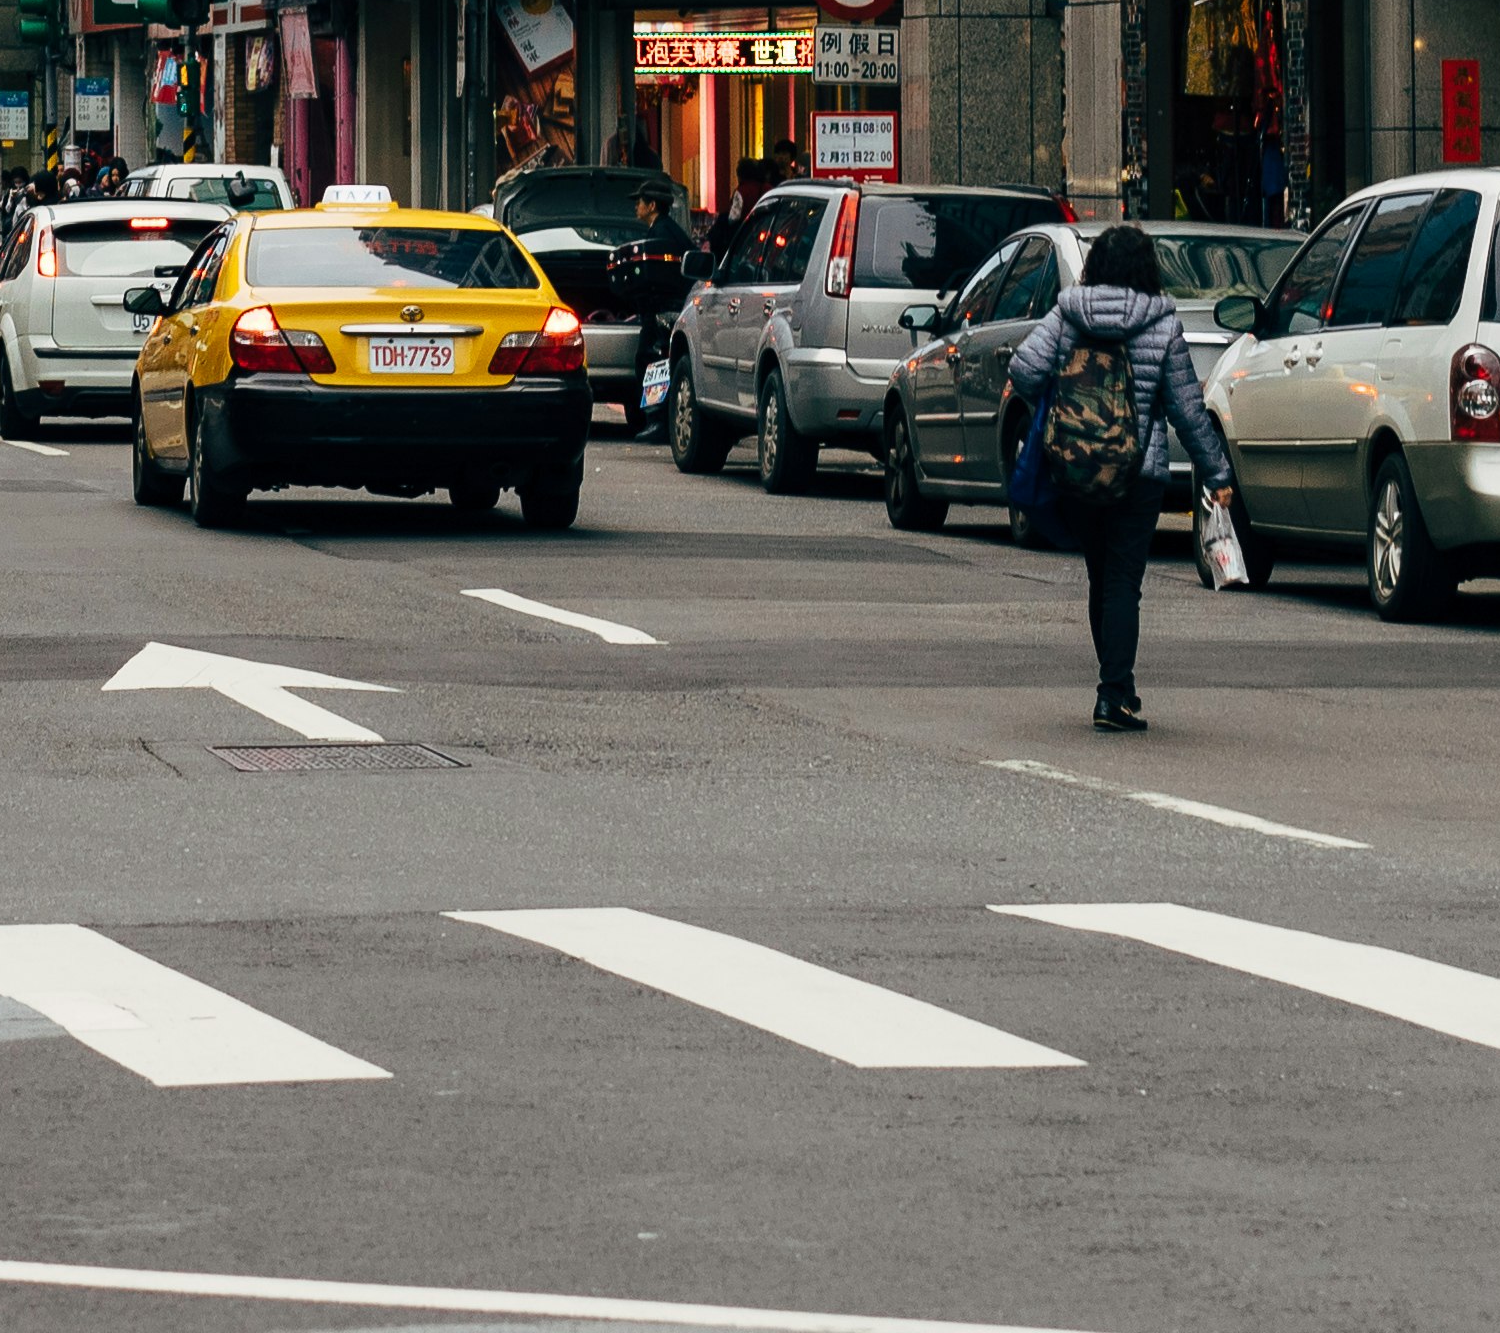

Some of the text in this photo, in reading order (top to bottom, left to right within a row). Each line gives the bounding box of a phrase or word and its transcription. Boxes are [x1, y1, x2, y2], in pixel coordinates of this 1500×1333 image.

[820, 33, 895, 55] 例假日
[333, 189, 384, 200] TAXI
